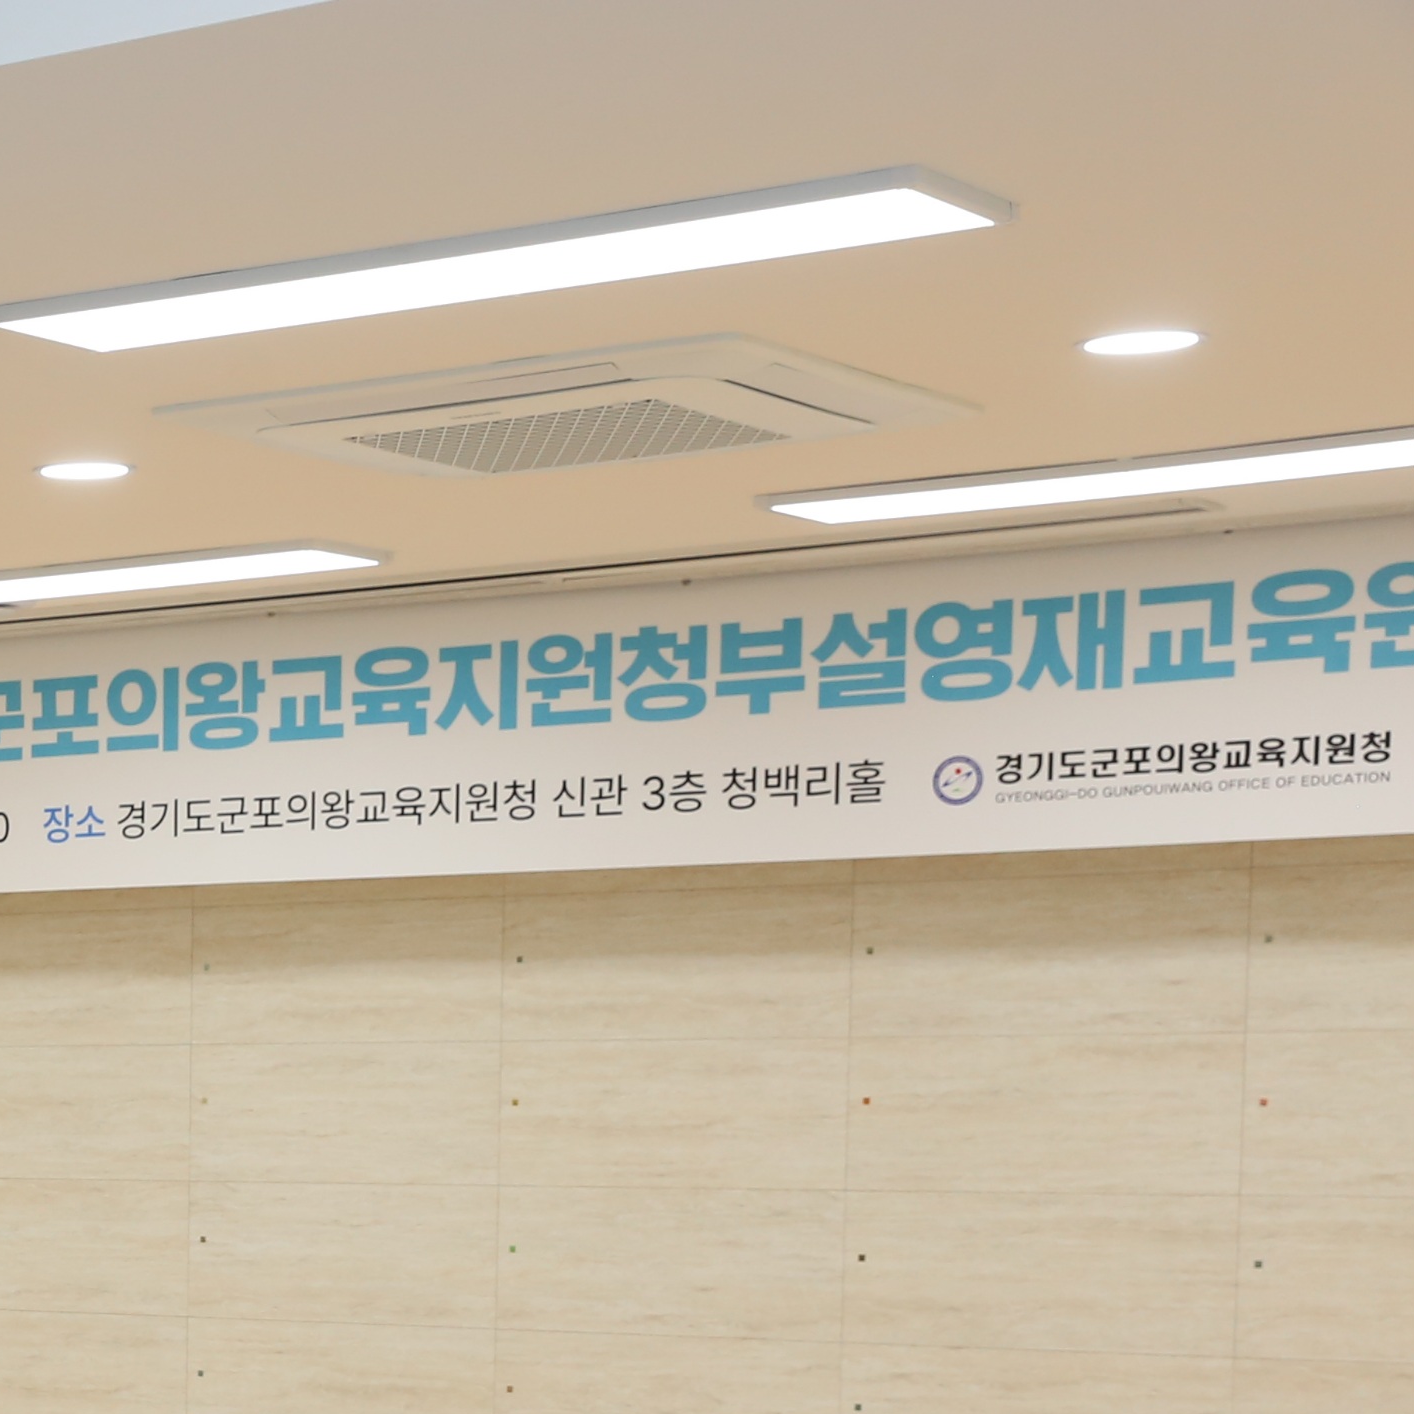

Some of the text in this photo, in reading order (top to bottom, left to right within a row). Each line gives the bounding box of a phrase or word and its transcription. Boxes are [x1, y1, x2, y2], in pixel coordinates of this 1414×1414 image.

[995, 731, 1393, 785] 경기도군포의왕교육지원청
[43, 804, 107, 846] 장소
[117, 778, 539, 841] 경기도군포의왕교육지원청
[553, 773, 630, 820] 신관
[642, 769, 708, 814] 3층
[721, 759, 888, 812] 청백리홀
[995, 770, 1392, 804] GYEONGGI-DO GUNPOUIWANG OFFICE OF EDUCATION
